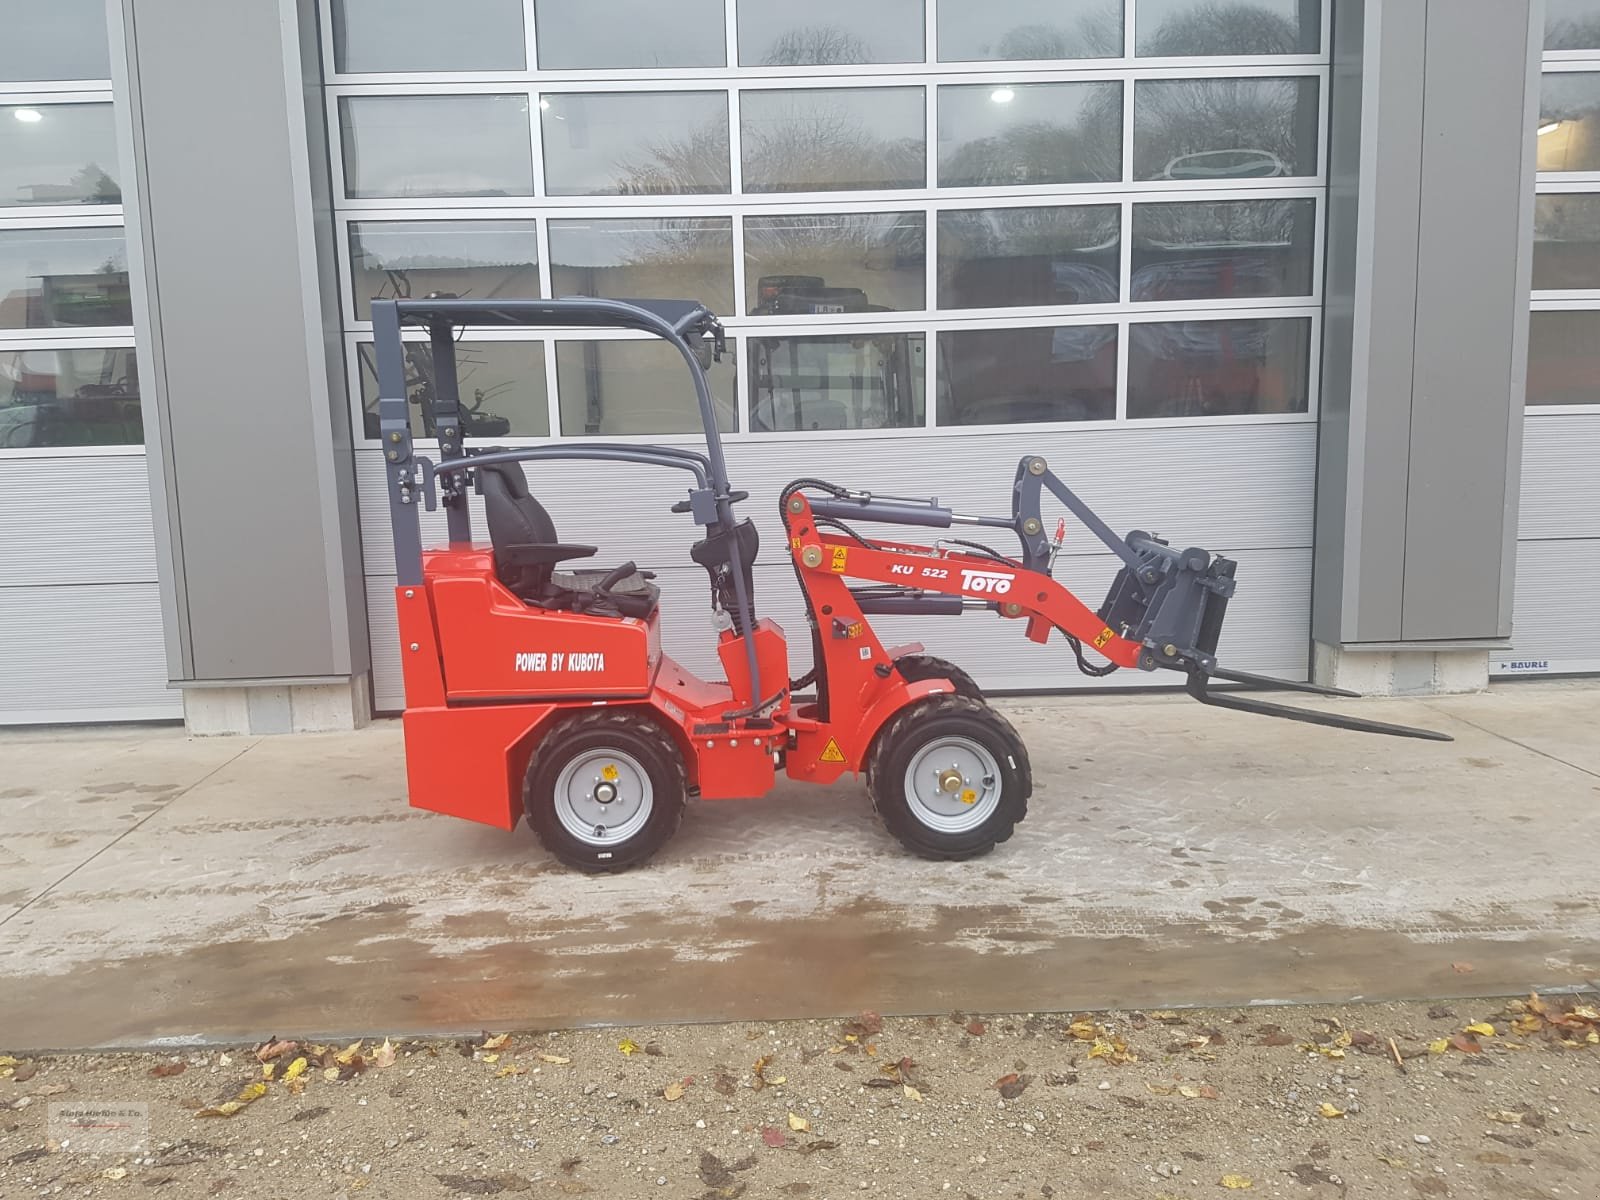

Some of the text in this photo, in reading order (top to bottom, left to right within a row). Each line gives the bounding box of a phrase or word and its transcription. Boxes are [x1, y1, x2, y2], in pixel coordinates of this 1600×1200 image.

[891, 564, 949, 579] KU 522
[960, 569, 1016, 594] TOYO
[515, 652, 605, 672] POWER BY KUBOTA
